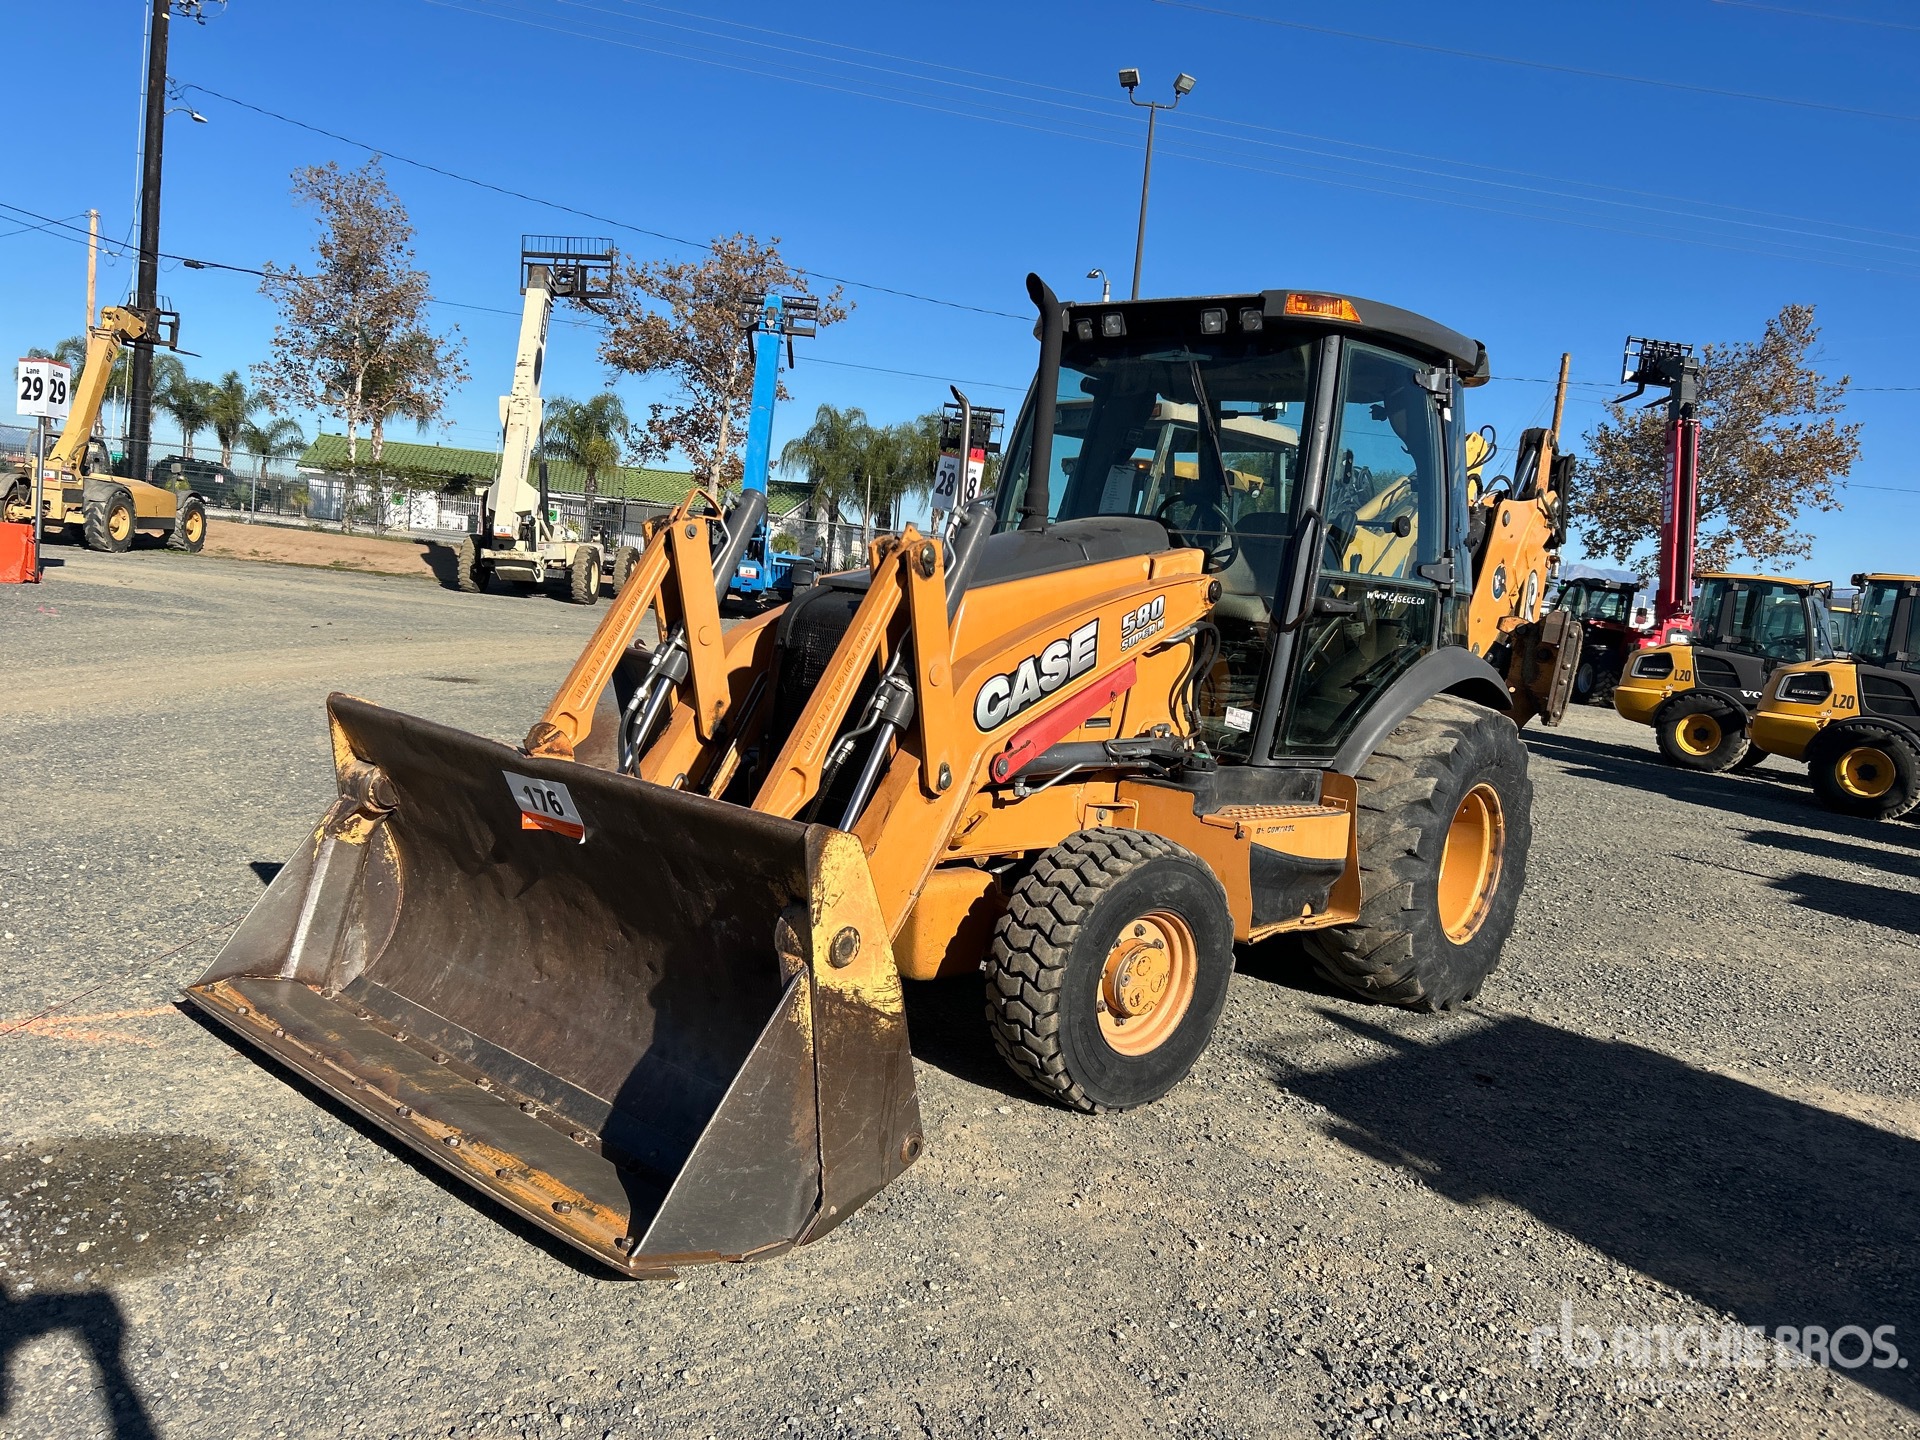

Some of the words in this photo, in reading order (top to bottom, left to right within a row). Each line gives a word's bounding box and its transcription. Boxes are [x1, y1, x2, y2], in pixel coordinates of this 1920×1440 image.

[26, 367, 40, 375] Lane
[52, 370, 64, 379] Lane
[21, 376, 43, 401] 29
[49, 378, 66, 405] 29
[944, 461, 956, 470] Lane
[935, 470, 956, 497] 28
[966, 477, 977, 501] 8
[1663, 452, 1674, 524] FARESIN
[1121, 595, 1165, 638] 580
[1121, 622, 1156, 652] SUPER
[1156, 616, 1165, 631] N
[974, 617, 1099, 732] CASE
[1674, 669, 1691, 682] L20
[1791, 688, 1820, 696] ELECTRIC
[1832, 693, 1855, 710] L20
[523, 785, 564, 816] 176
